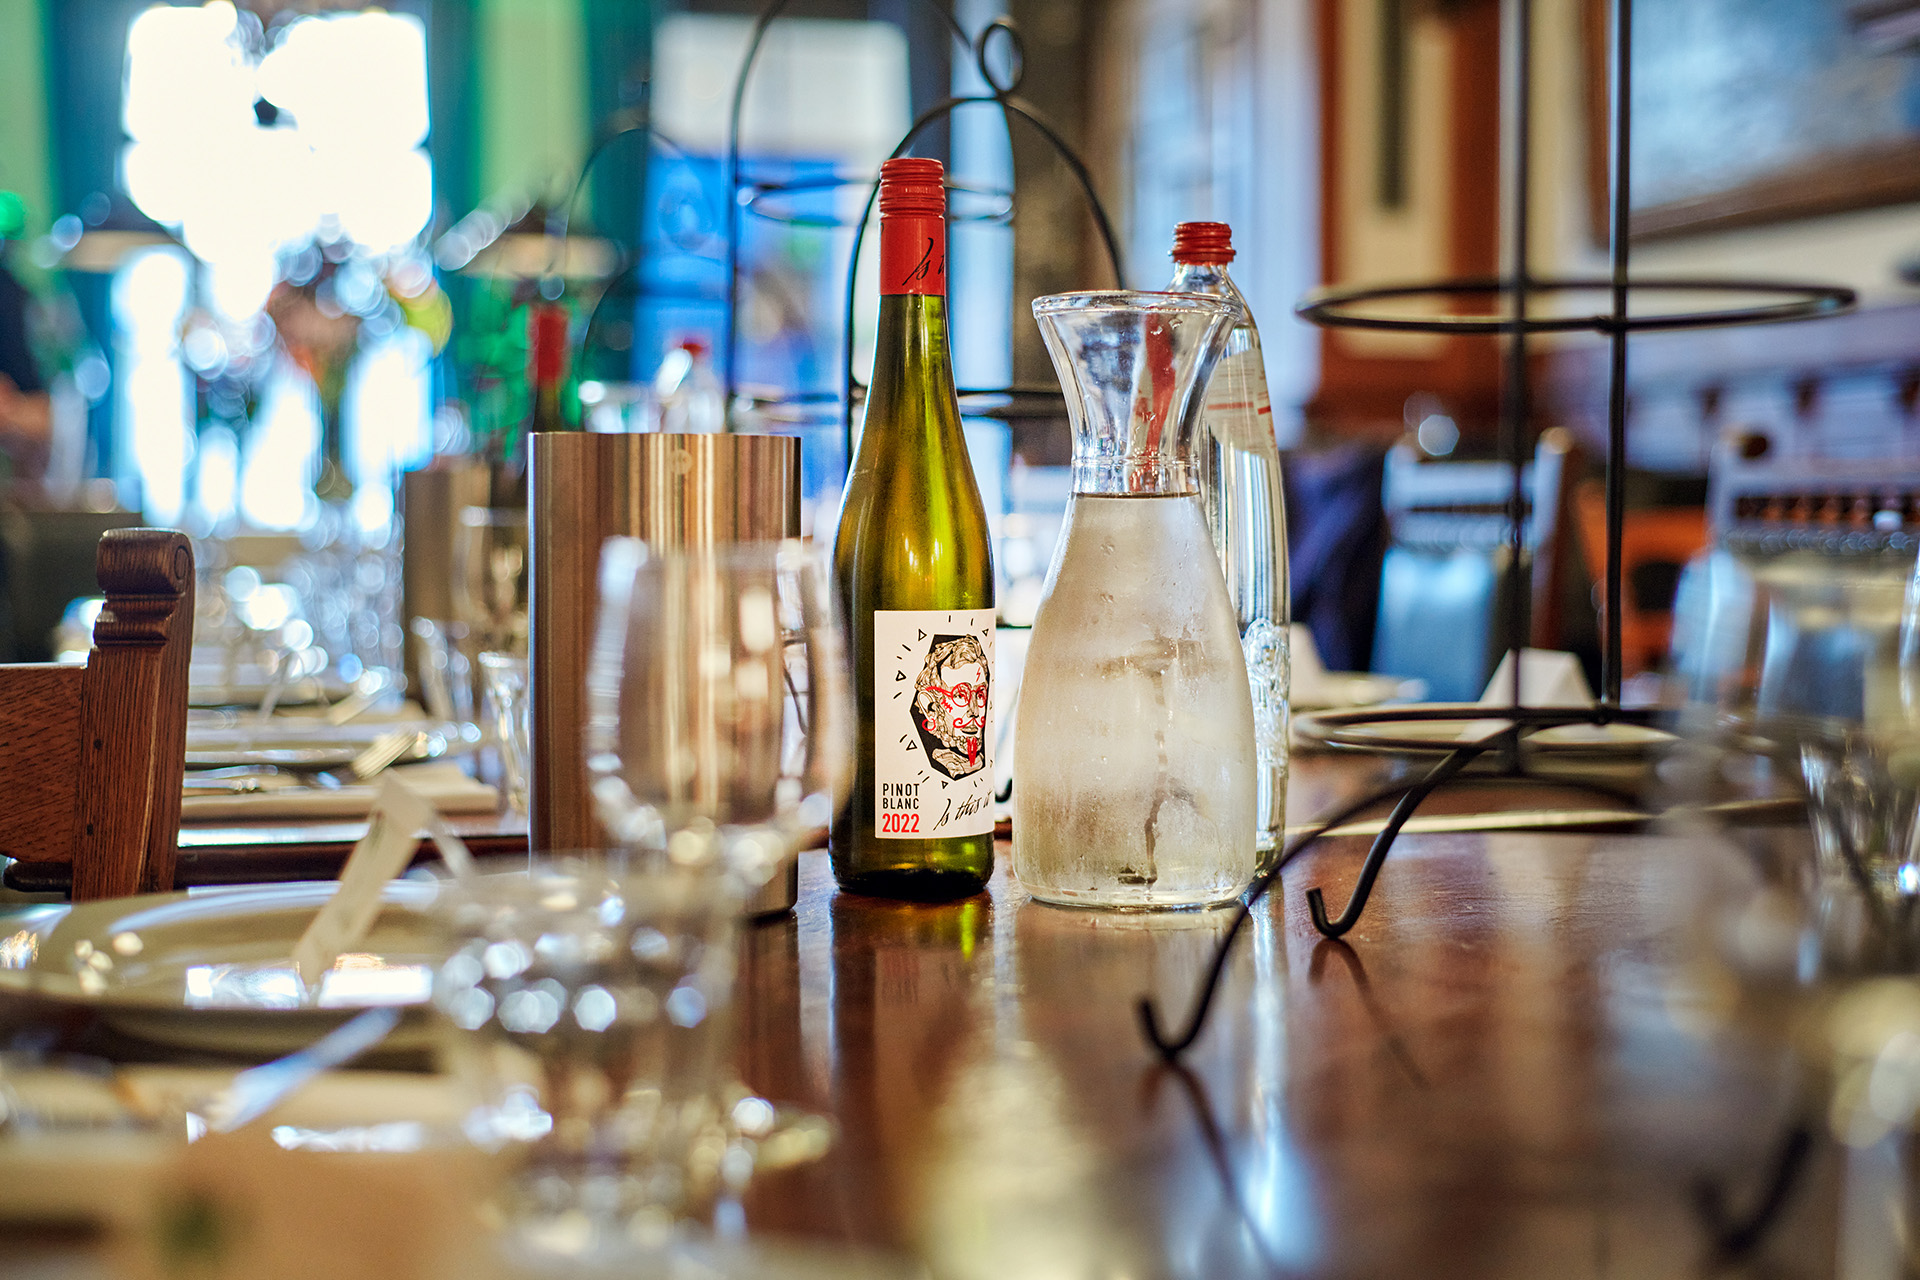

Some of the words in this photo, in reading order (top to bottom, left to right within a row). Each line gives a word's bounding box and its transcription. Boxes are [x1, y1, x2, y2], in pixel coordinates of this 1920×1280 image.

[882, 783, 920, 796] PINOT
[882, 798, 920, 810] BLANC
[954, 794, 982, 820] this
[882, 813, 920, 833] 2022
